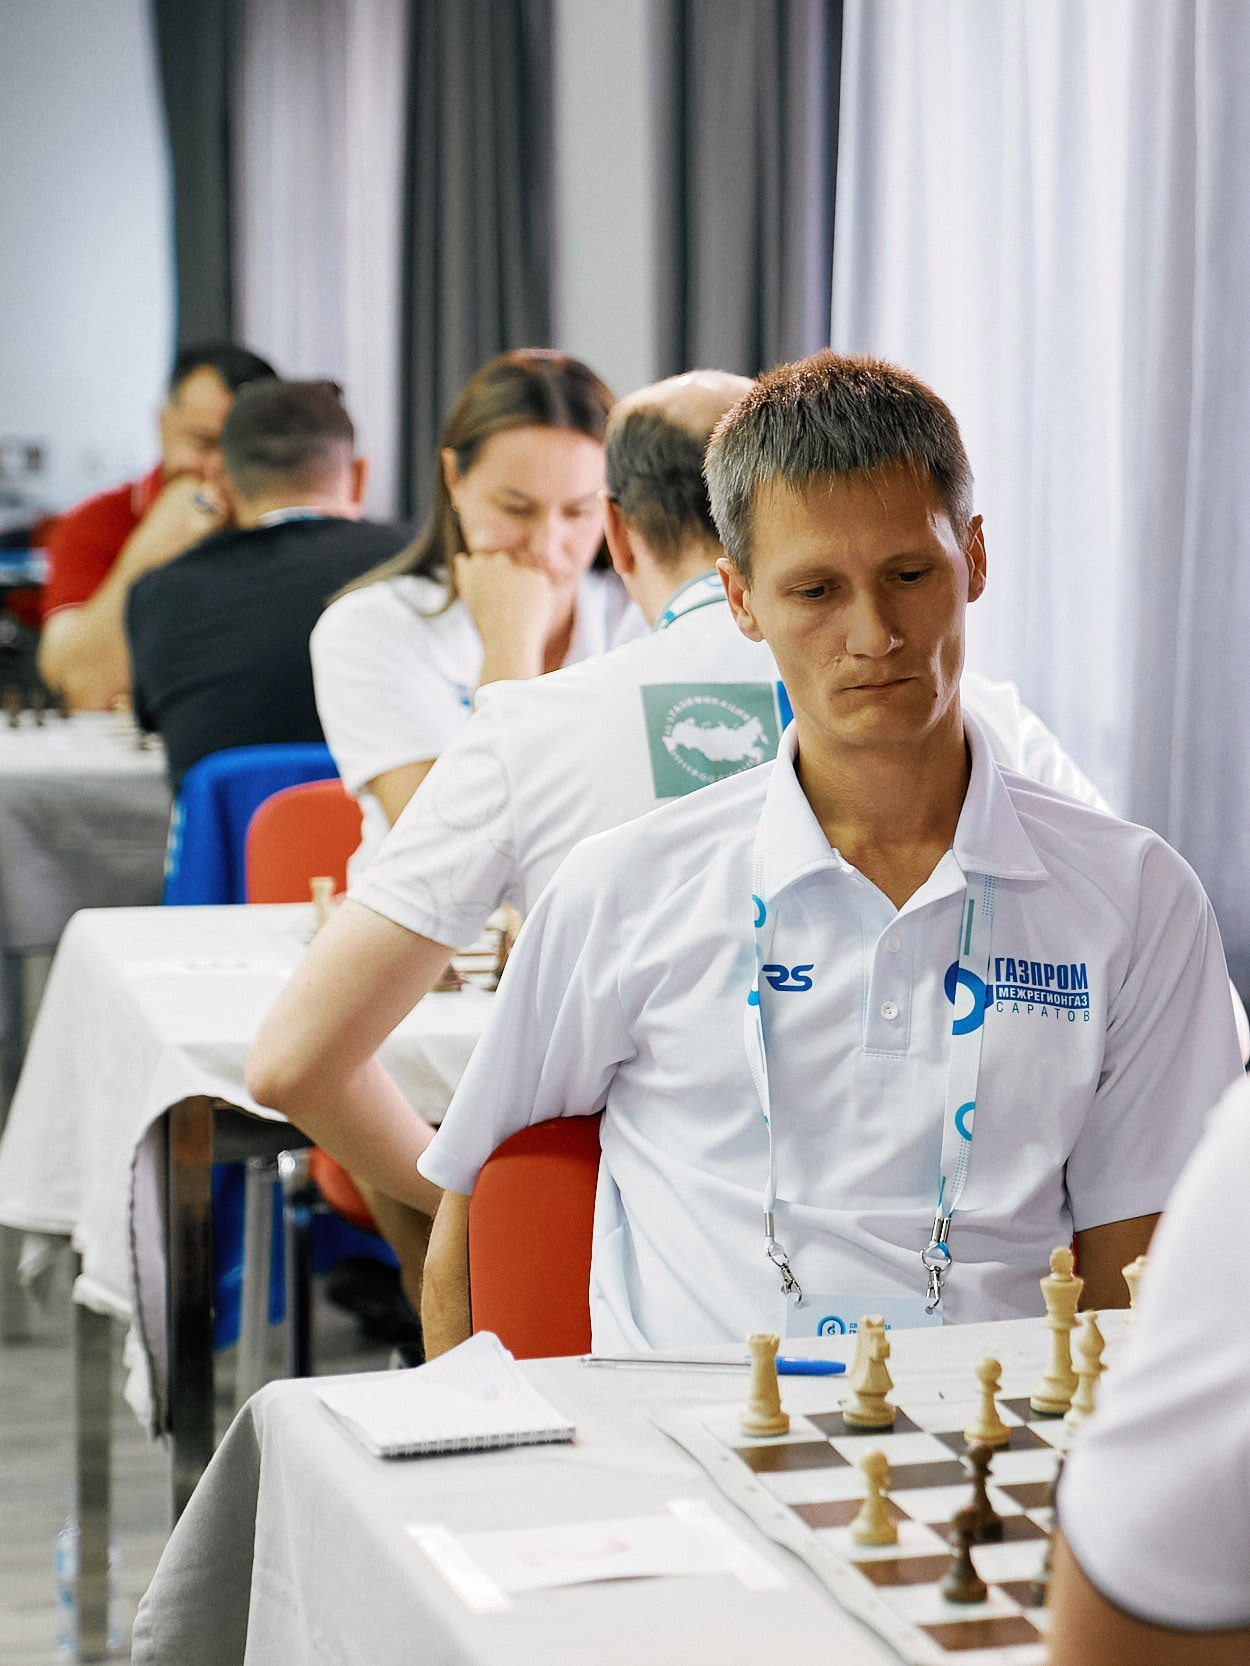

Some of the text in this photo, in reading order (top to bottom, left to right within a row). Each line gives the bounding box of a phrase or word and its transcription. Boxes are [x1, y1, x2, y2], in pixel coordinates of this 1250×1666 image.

[995, 957, 1088, 990] ГАЗПРОМ
[997, 987, 1088, 1007] МЕЖРЕГИОНГАЗ
[996, 1001, 1090, 1022] САРАТОВ
